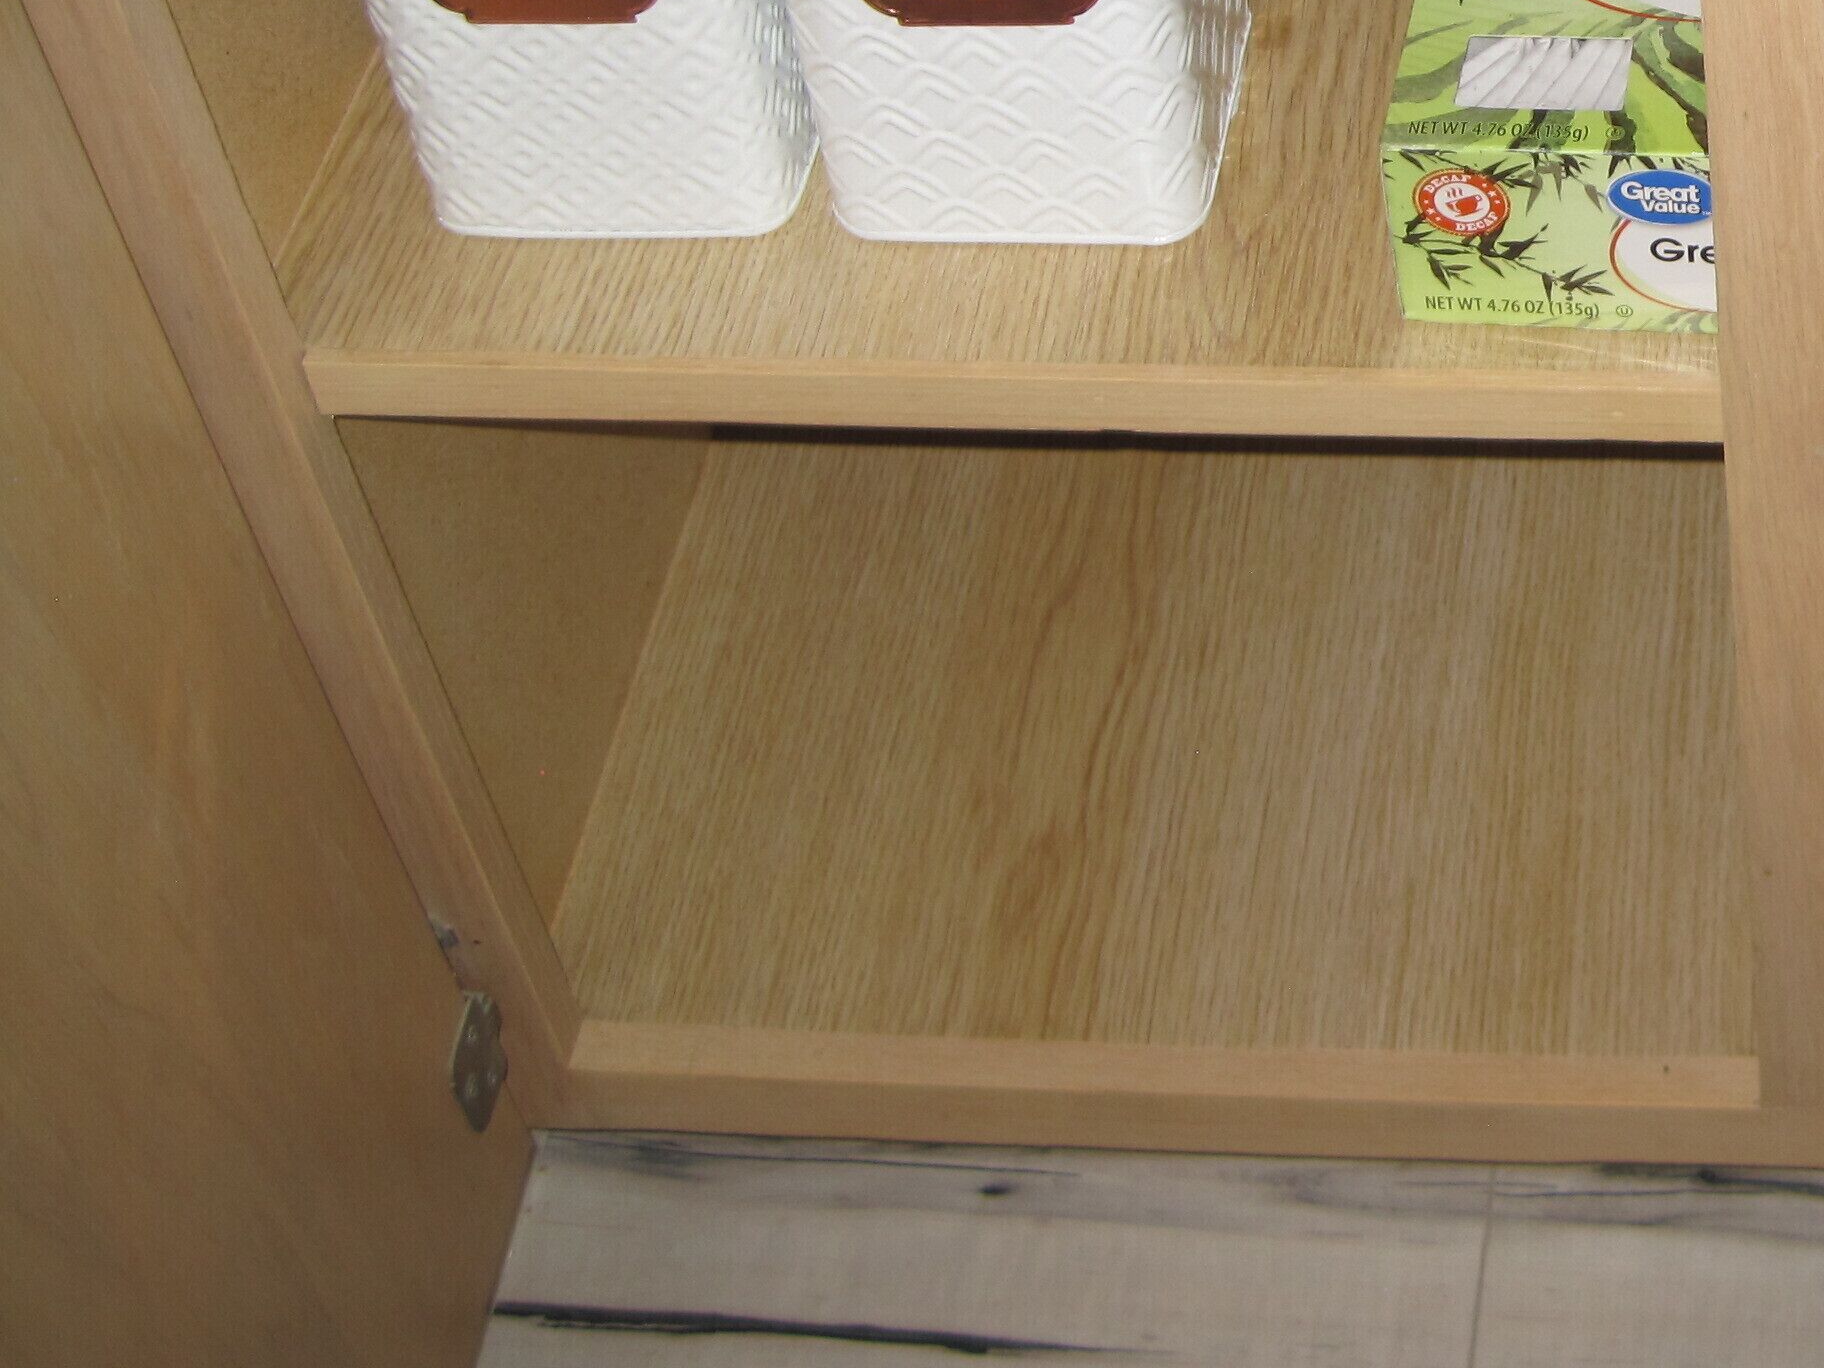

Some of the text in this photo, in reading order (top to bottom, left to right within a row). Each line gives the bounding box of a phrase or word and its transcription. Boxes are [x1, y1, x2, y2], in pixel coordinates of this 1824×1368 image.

[1409, 121, 1437, 134] NET
[1442, 122, 1468, 135] WT
[1473, 122, 1506, 136] 4.76
[1511, 123, 1534, 137] OZ
[1537, 123, 1589, 143] (135g)
[1424, 174, 1472, 194] DECAF
[1621, 181, 1701, 203] Great
[1641, 199, 1702, 215] Value
[1455, 211, 1499, 232] DECAF
[1425, 296, 1454, 310] NET
[1457, 297, 1483, 311] WT
[1487, 298, 1521, 313] 4.76
[1525, 300, 1545, 314] OZ
[1549, 300, 1600, 319] (135g)
